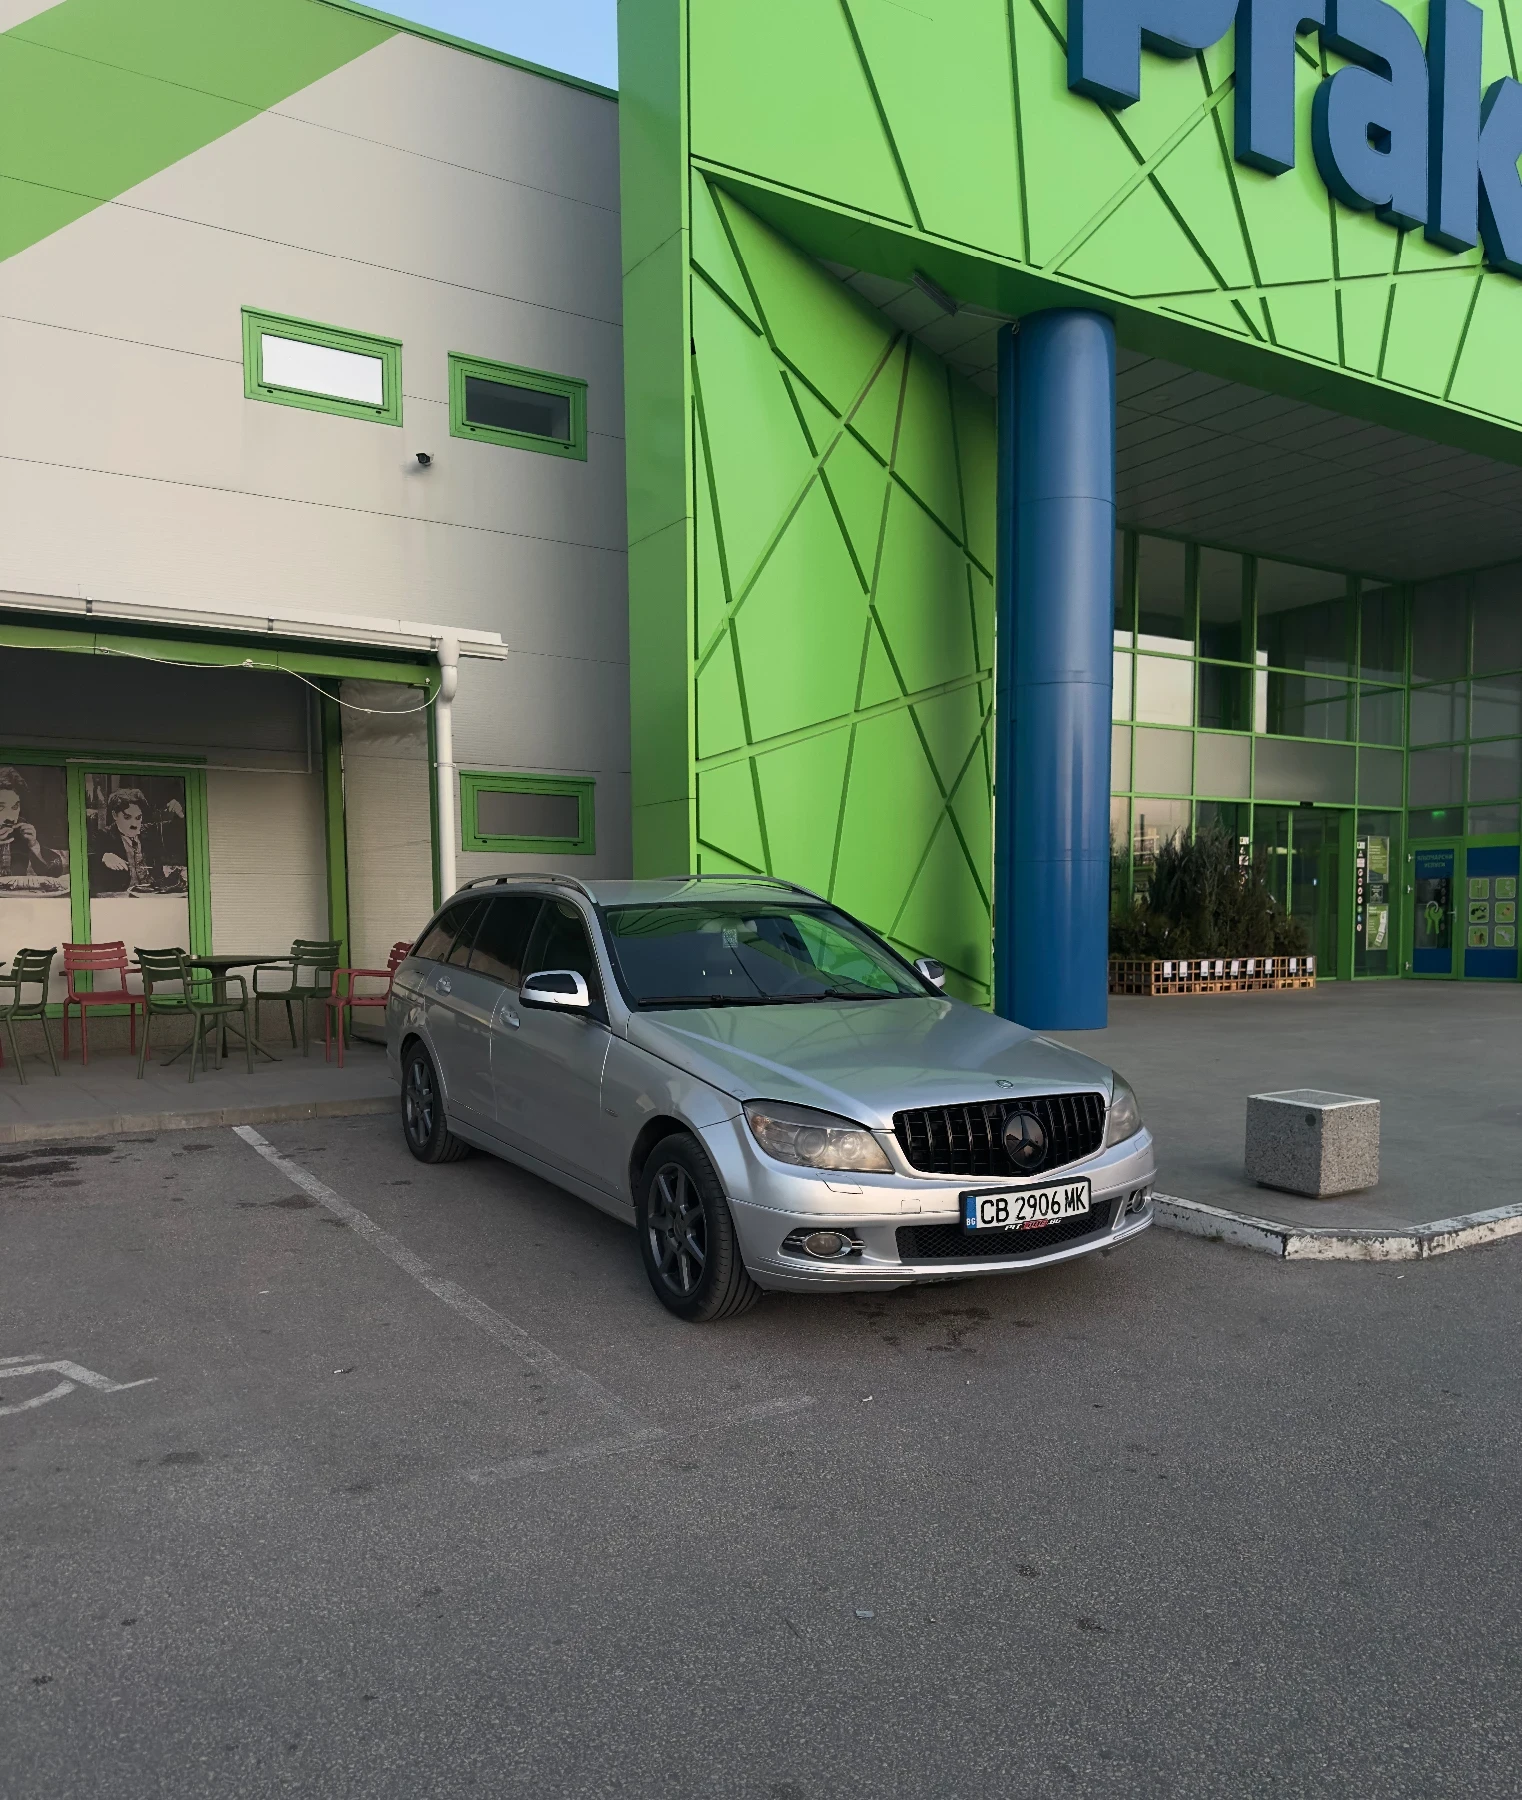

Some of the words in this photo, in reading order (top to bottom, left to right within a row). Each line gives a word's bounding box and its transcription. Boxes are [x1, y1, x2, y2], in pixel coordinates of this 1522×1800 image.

[980, 1198, 1010, 1224] CB
[1014, 1191, 1061, 1221] 2906
[1064, 1185, 1087, 1213] MK
[966, 1217, 976, 1226] BG
